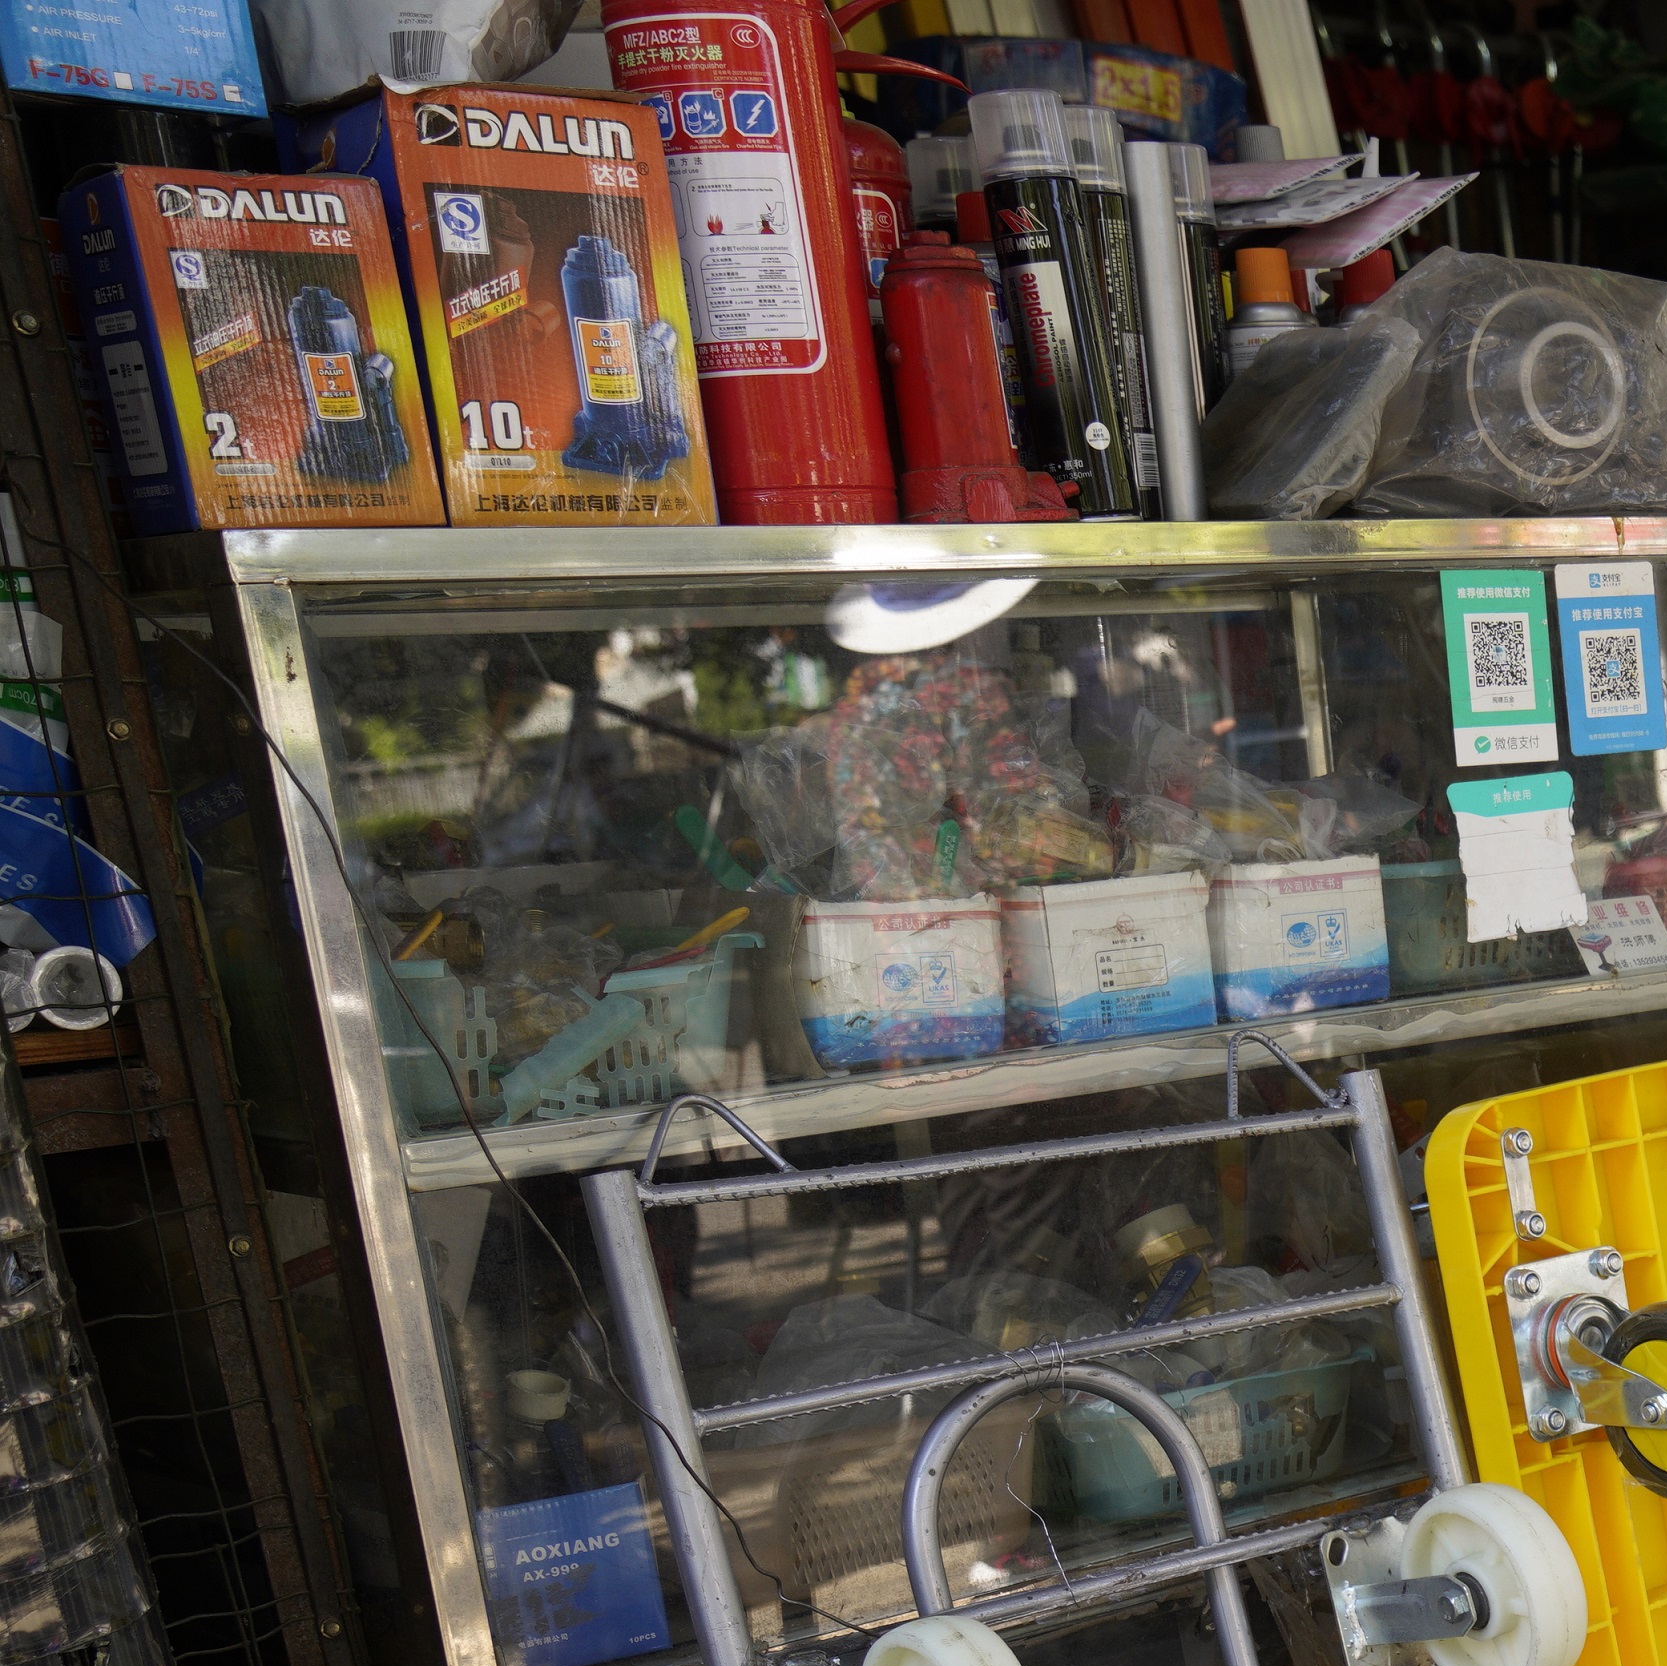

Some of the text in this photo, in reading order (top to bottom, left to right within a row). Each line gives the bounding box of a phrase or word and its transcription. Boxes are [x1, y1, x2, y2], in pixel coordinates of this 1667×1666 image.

[38, 5, 122, 25] AIR PRESSURE
[43, 27, 97, 42] AIR INLET
[623, 26, 701, 47] MFZ/ABC2型
[618, 45, 723, 69] 手提式干粉灭火器
[648, 64, 670, 74] powder
[671, 63, 682, 71] fire
[683, 62, 727, 71] extinguisher
[28, 59, 217, 100] F-75G F-75S
[463, 106, 635, 161] DALUN
[592, 164, 639, 188] 达伦
[197, 188, 346, 225] DALUN
[82, 229, 116, 255] DALUN
[310, 229, 353, 247] 达伦
[1036, 235, 1051, 249] HUI
[450, 270, 521, 318] 立式油压千斤顶
[1019, 272, 1056, 387] Chromeplate
[592, 339, 621, 347] DALUN
[1053, 341, 1065, 383] AEROSOL
[474, 494, 658, 512] 上海达伦机械有限公司
[1457, 586, 1531, 599] 推荐使用微信支付
[1571, 606, 1644, 622] 推荐使用支付宝
[1494, 736, 1539, 751] 微信支付
[1493, 790, 1532, 805] 推荐使用
[1325, 939, 1343, 947] UKAS
[1620, 934, 1657, 947] 洪师傅
[928, 984, 950, 993] UKAS
[516, 1532, 620, 1565] AOXIANG
[629, 1632, 657, 1644] 10PCS
